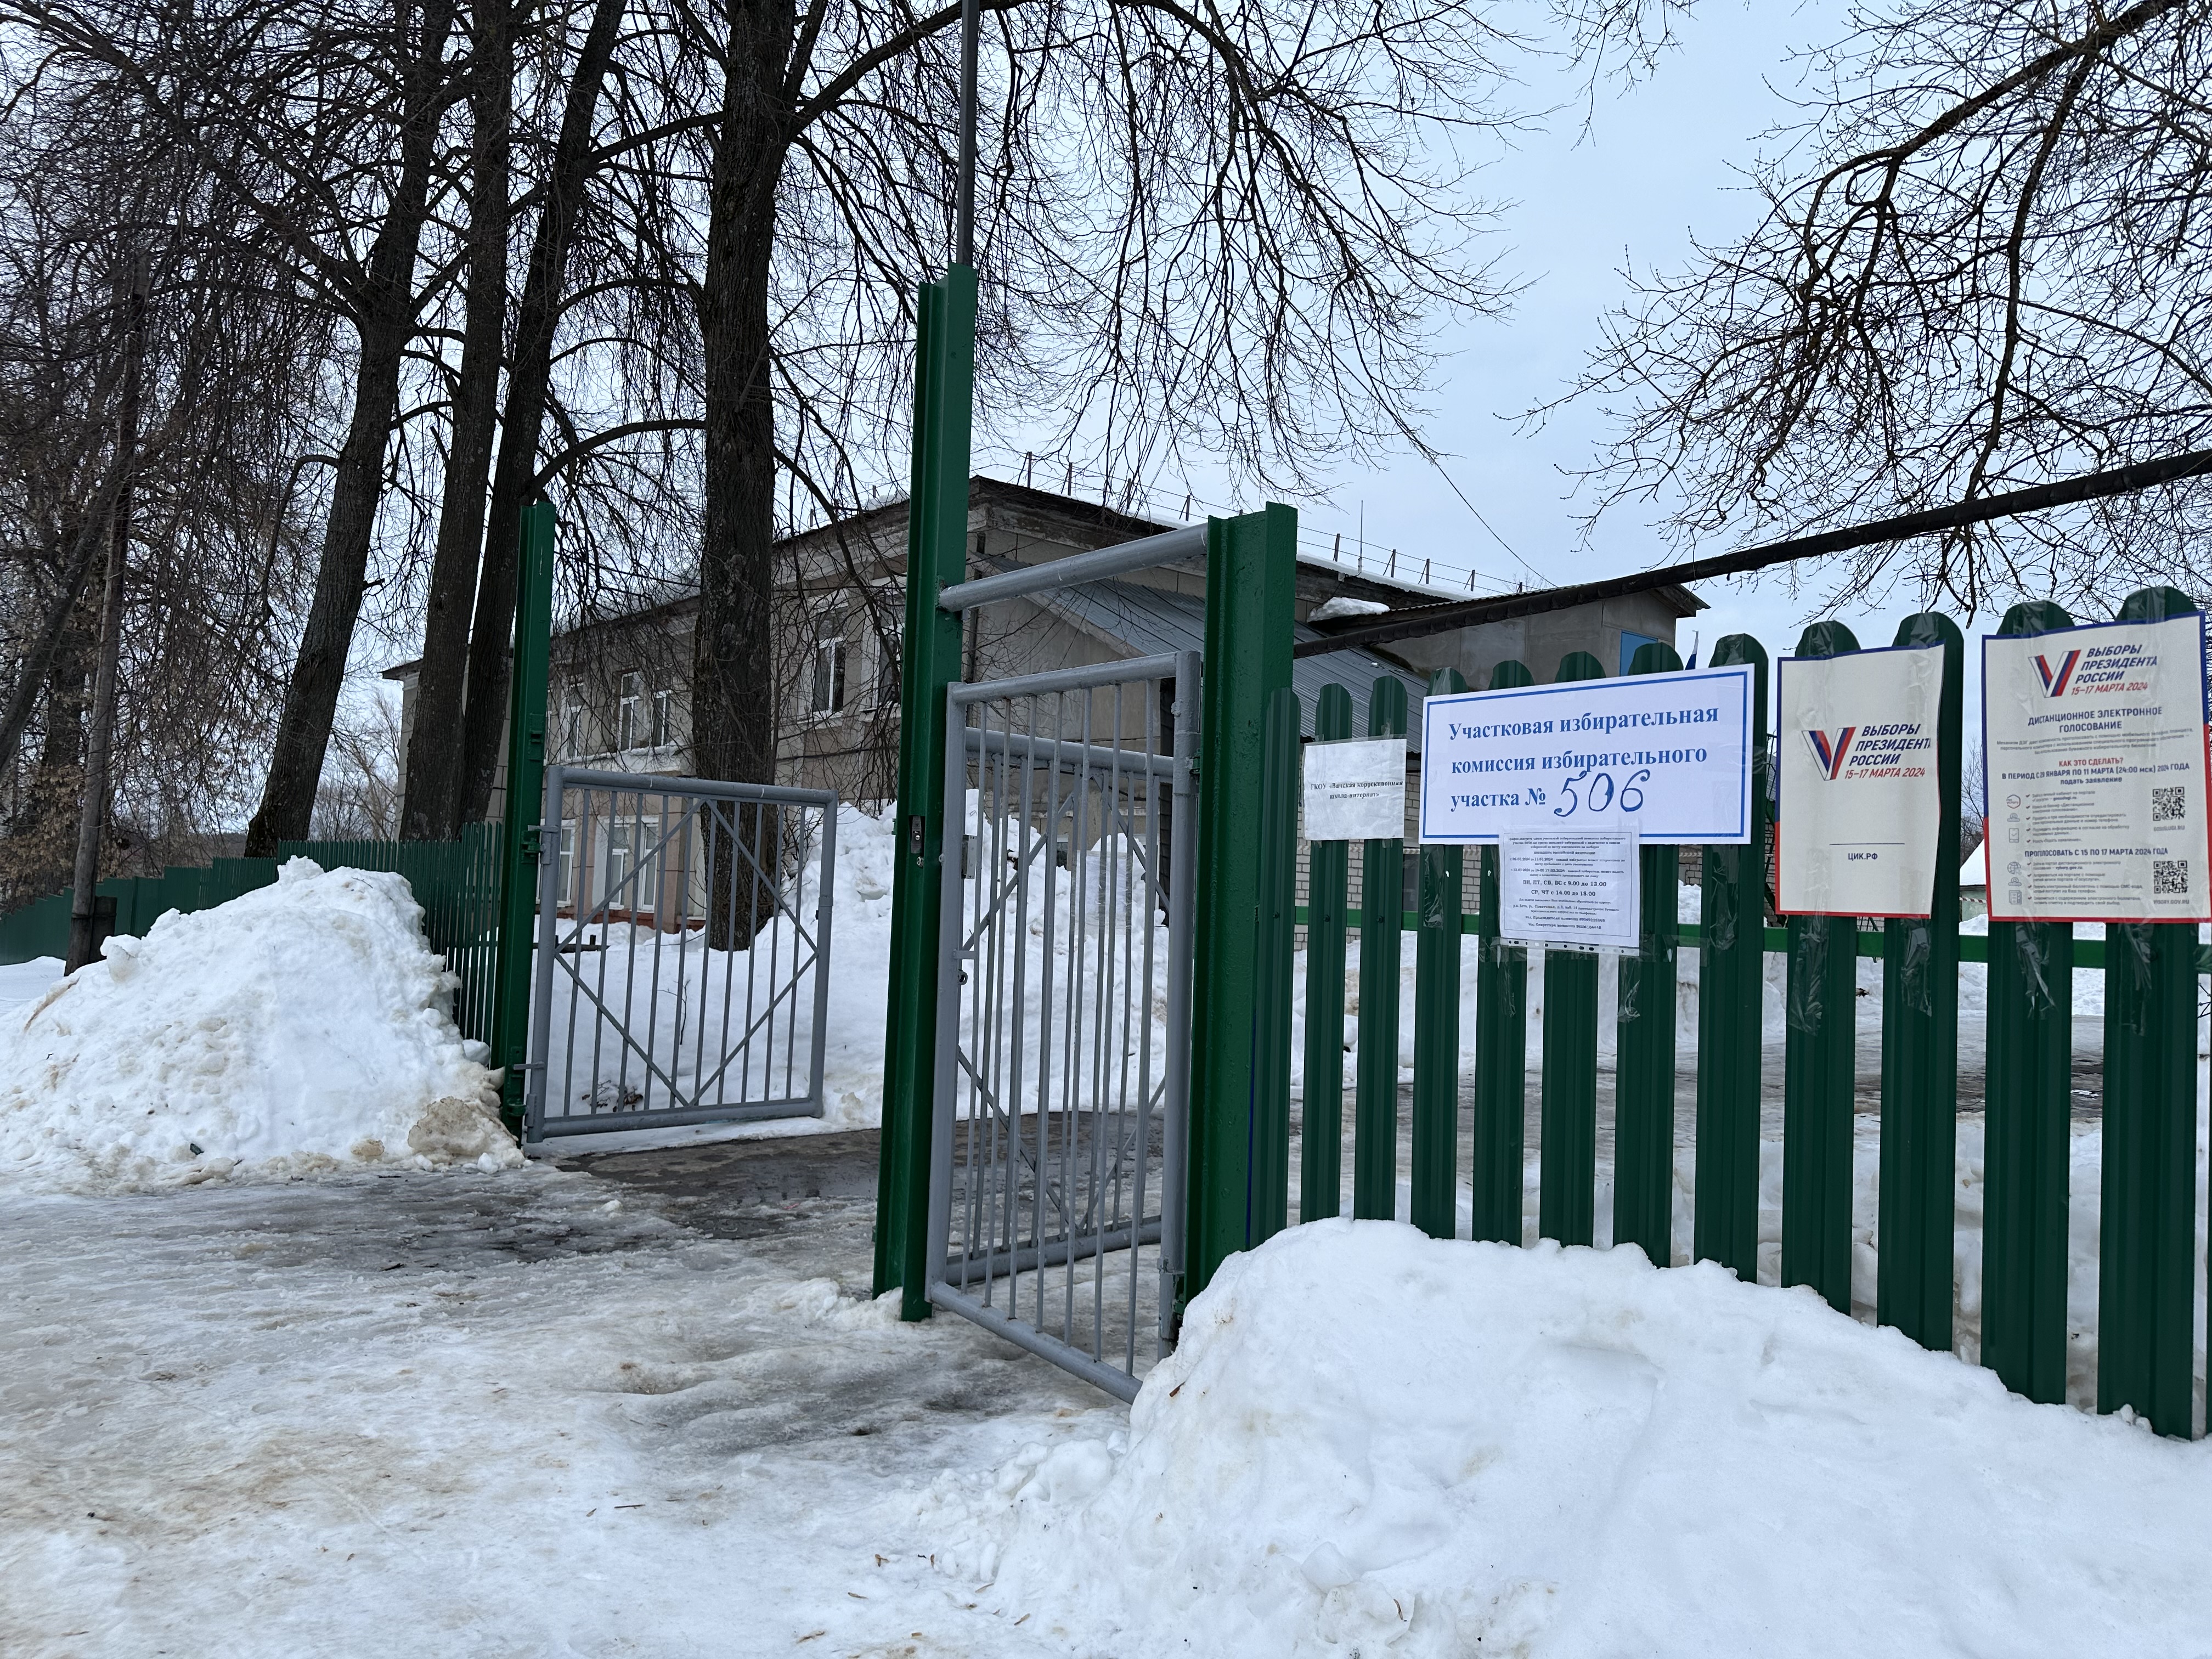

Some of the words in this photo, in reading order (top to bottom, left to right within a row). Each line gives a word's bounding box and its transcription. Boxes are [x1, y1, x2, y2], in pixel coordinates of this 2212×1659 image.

[2086, 644, 2143, 658] ВЫБОРЫ
[2080, 656, 2157, 671] ПРЕЗИДЕНТА
[2075, 670, 2125, 684] РОССИИ
[2094, 683, 2125, 693] МАРТА
[2126, 682, 2148, 691] 2024
[2097, 707, 2163, 718] ЭЛЕКТРОННОЕ
[1448, 719, 1554, 740] Участковая
[1560, 707, 1719, 733] избирательная
[1861, 724, 1921, 736] ВЫБОРЫ
[2059, 720, 2122, 733] ГОЛОСОВАНИЕ
[1452, 756, 1536, 774] комиссия
[1542, 748, 1707, 772] избирательного
[1849, 754, 1901, 766] РОССИИ
[2088, 757, 2124, 766] СДЕЛАТЬ?
[1869, 768, 1900, 778] МАРТА
[1902, 768, 1925, 777] 2024
[2046, 769, 2070, 777] ЯНВАРЯ
[2170, 763, 2190, 771] ГОДА
[1451, 794, 1520, 811] участка
[1525, 788, 1546, 806] №
[1554, 769, 1651, 817] 506
[1848, 853, 1878, 861] ЦИК.РФ
